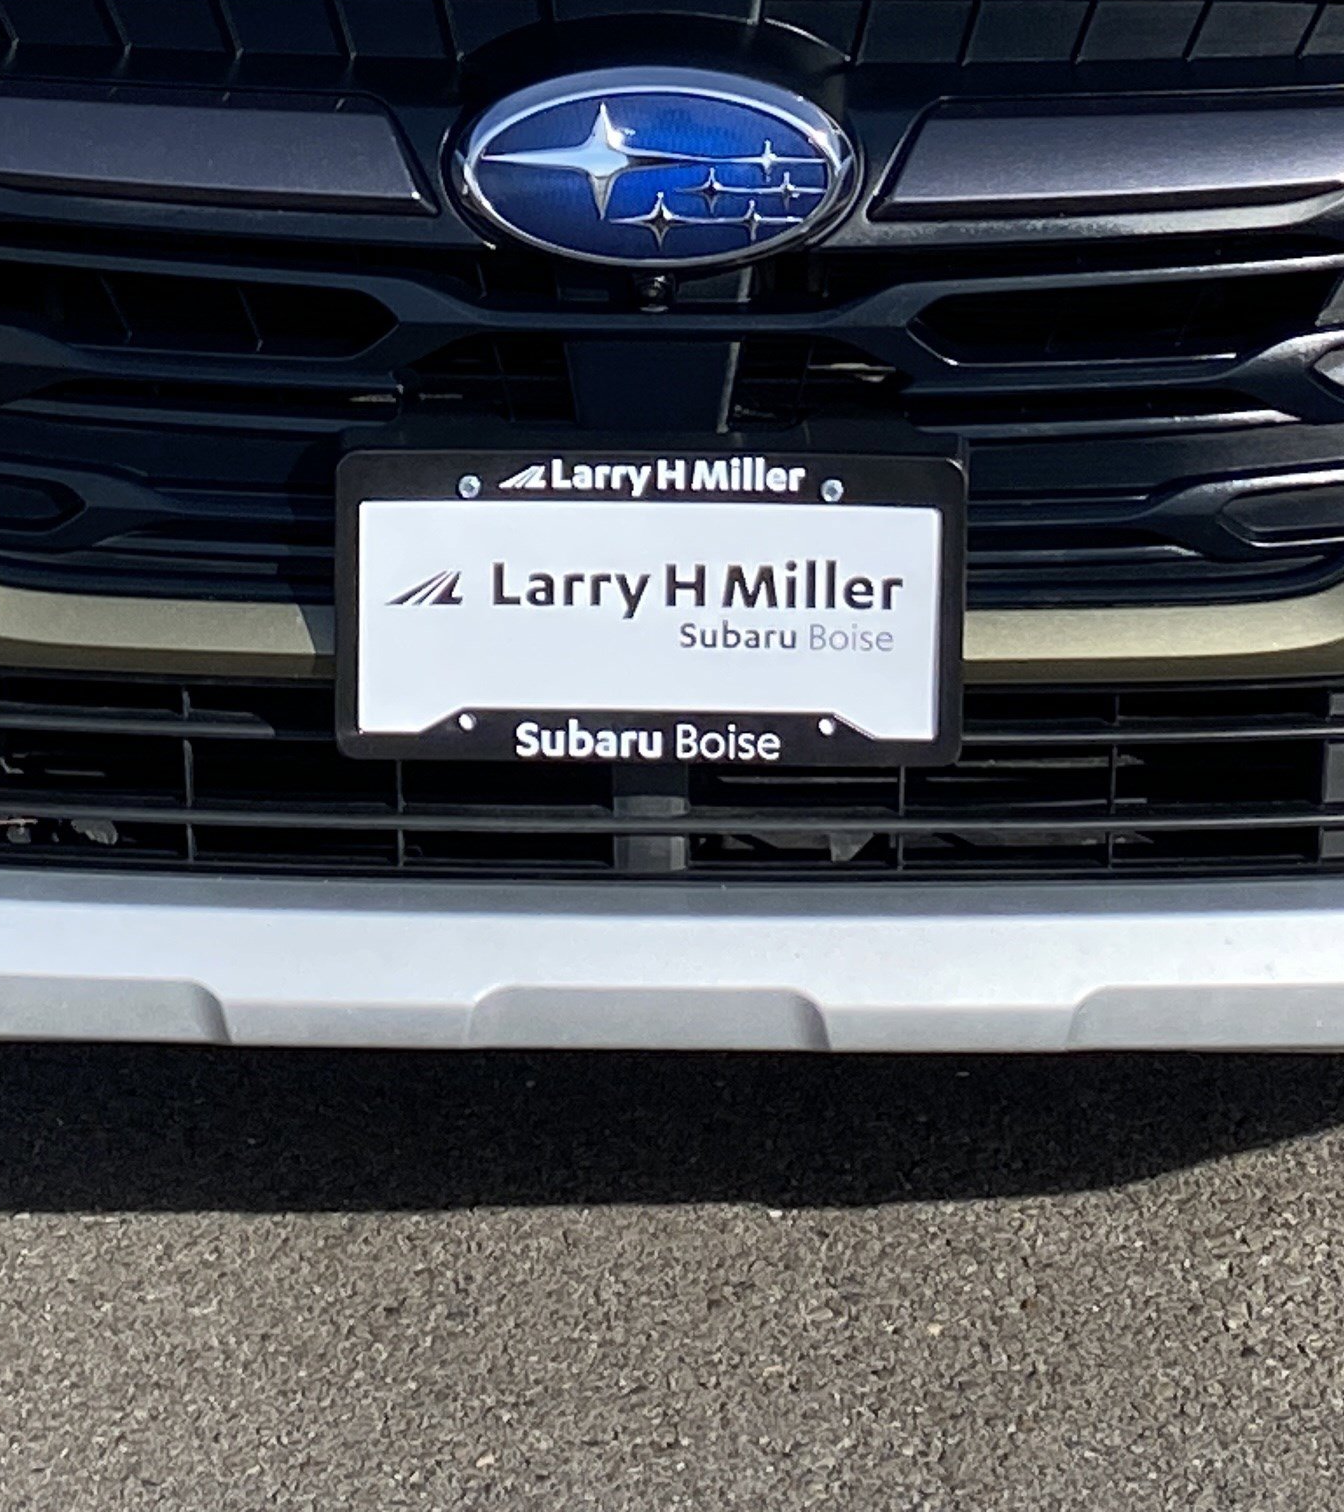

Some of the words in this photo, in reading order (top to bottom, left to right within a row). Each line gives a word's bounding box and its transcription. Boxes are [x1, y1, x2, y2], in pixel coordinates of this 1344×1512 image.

[551, 458, 652, 498] Larry
[657, 459, 685, 491] H
[691, 456, 806, 493] Miller
[493, 562, 651, 619] Larry
[665, 563, 706, 608] H
[722, 559, 904, 611] Miller
[679, 620, 798, 650] Subaru
[809, 623, 894, 653] Boise
[515, 718, 663, 759] Subaru
[676, 723, 782, 761] Boise
